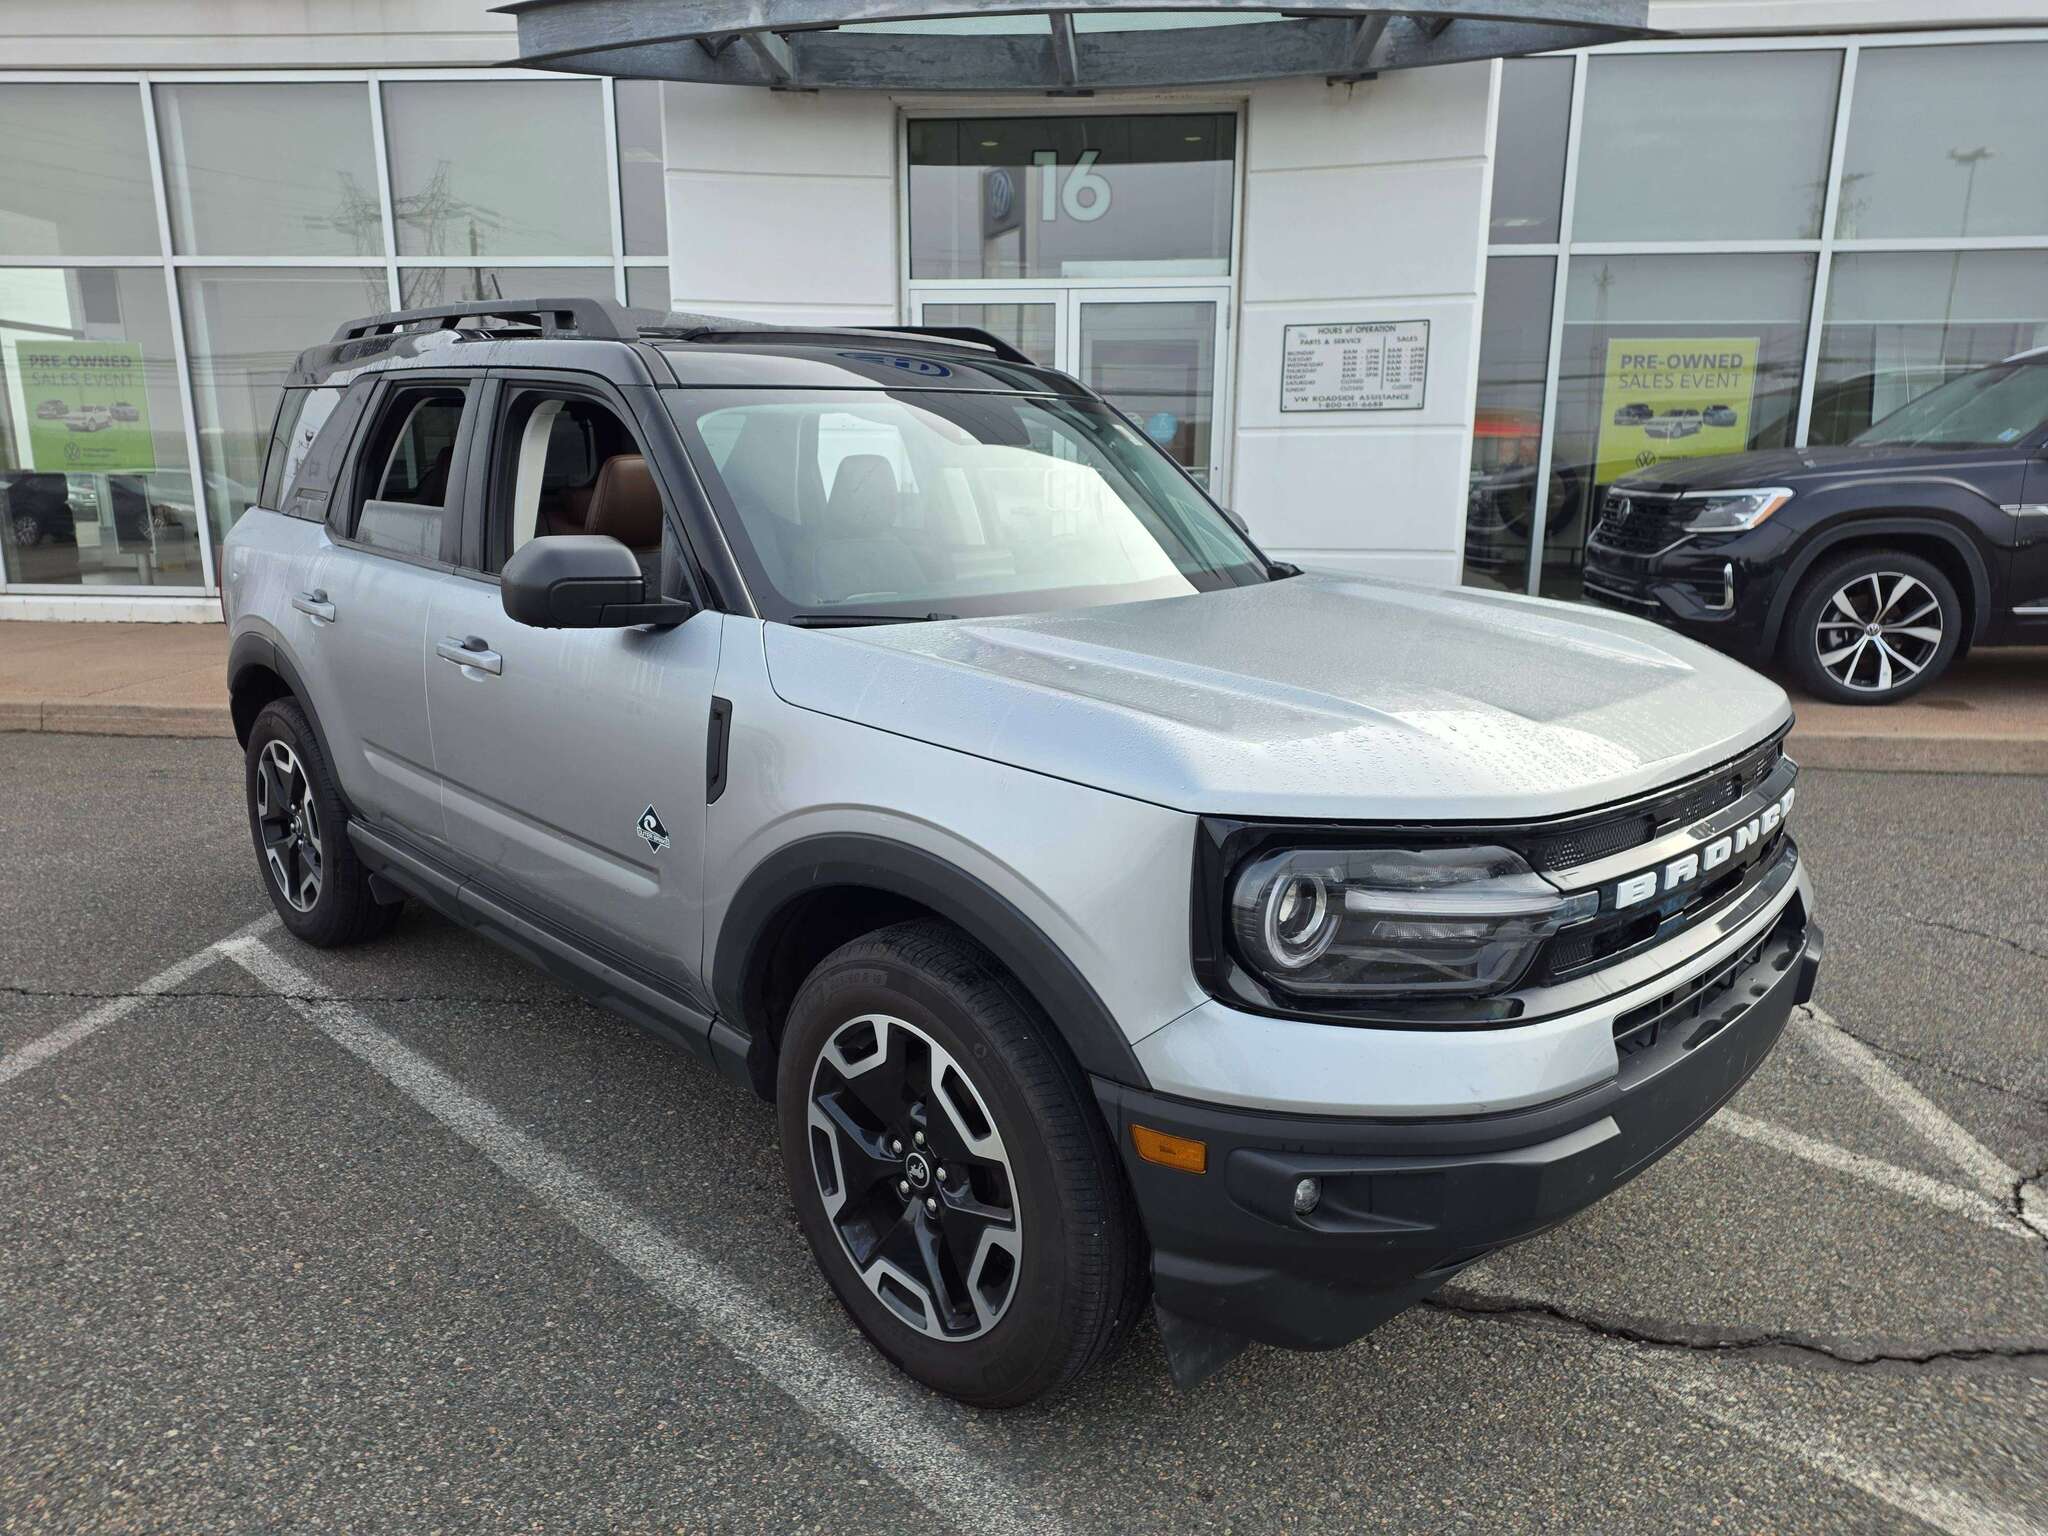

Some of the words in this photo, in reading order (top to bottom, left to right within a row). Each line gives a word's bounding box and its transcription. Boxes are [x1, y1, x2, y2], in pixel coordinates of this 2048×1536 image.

[1032, 149, 1112, 222] 16
[1318, 327, 1343, 335] HOURS
[1355, 325, 1397, 333] OPERATION
[1397, 335, 1418, 343] SALES
[28, 354, 132, 368] PRE-OWNED
[1620, 353, 1743, 369] PRE-OWNED
[32, 371, 79, 386] SALES
[84, 373, 133, 387] EVENT
[1619, 373, 1674, 389] SALES
[1680, 373, 1742, 389] EVENT
[1312, 394, 1354, 402] ROADSIDE
[1359, 393, 1409, 401] ASSISTANCE
[1616, 788, 1795, 909] BRONCO
